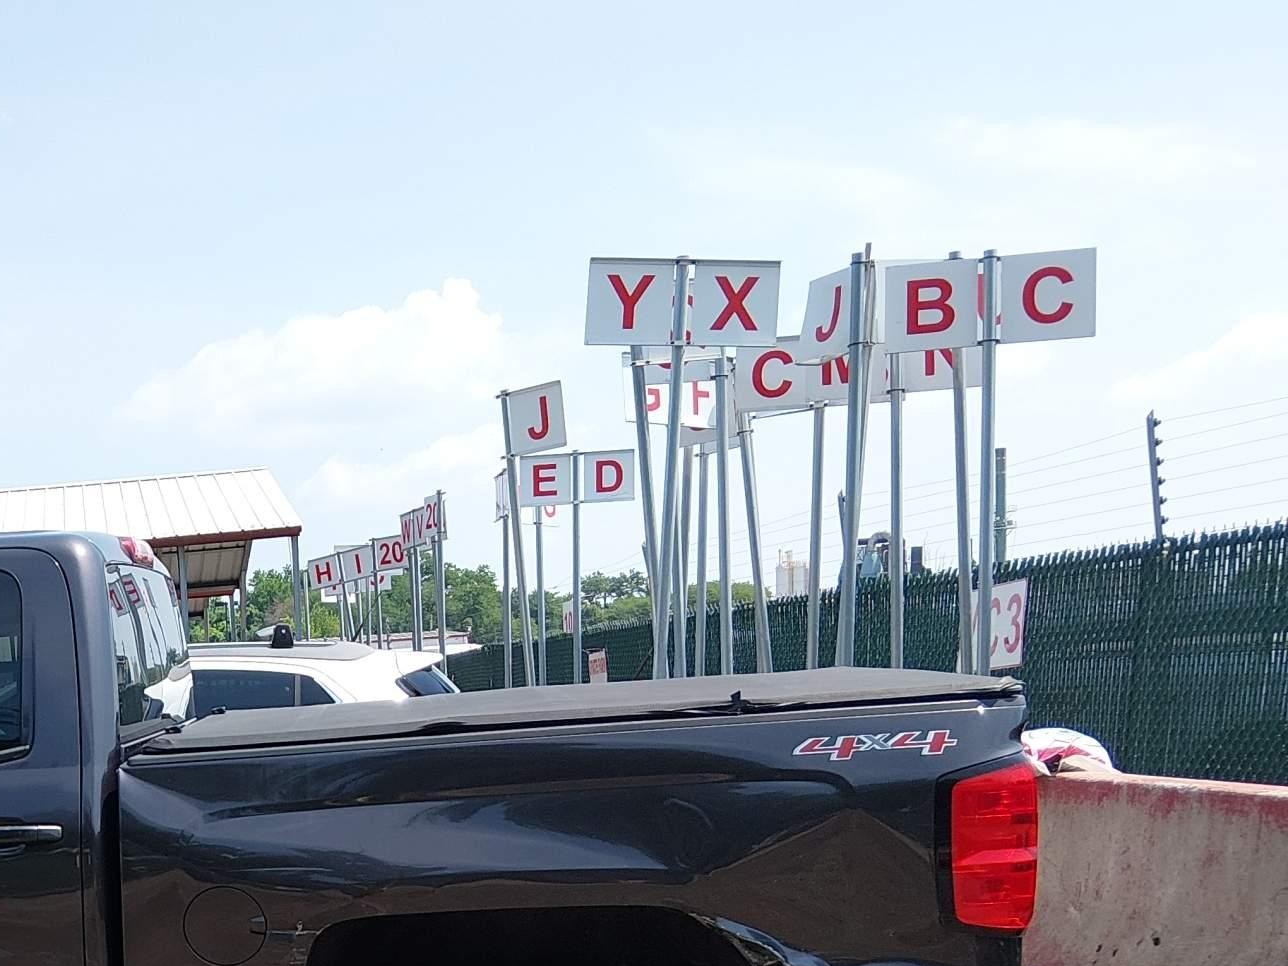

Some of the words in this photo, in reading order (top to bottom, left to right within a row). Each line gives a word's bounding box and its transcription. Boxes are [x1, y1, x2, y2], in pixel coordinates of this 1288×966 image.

[607, 275, 656, 330] Y
[710, 276, 760, 331] X
[815, 285, 842, 343] J
[907, 278, 955, 335] B
[1022, 266, 1075, 324] C
[752, 351, 793, 398] C
[527, 396, 548, 440] J
[533, 463, 558, 497] E
[596, 460, 623, 493] D
[416, 513, 424, 539] V
[315, 561, 332, 584] H
[379, 541, 404, 565] 20
